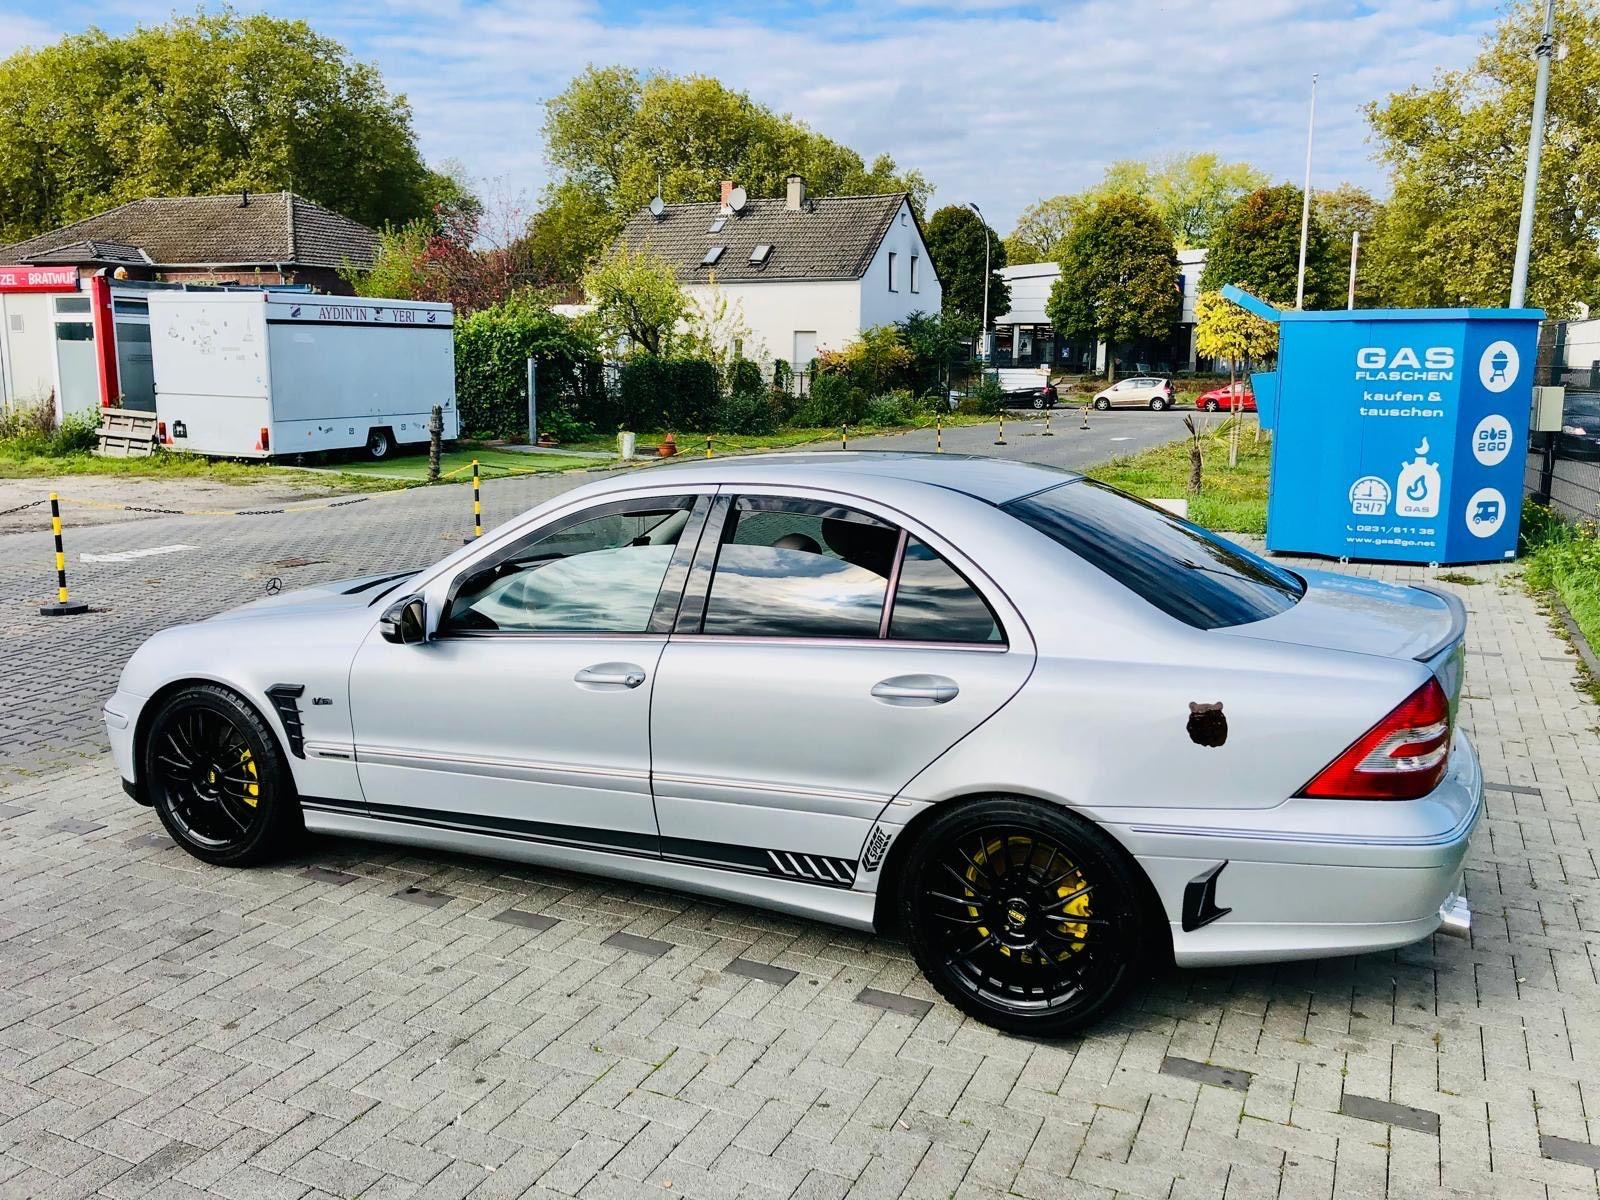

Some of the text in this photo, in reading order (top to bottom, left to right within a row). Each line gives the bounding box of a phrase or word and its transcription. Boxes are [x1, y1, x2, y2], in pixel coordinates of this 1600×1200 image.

[392, 310, 415, 322] YERI
[1356, 347, 1454, 369] GAS
[1355, 371, 1453, 381] FLASCHEN
[1363, 391, 1442, 402] kaufen &
[1360, 406, 1444, 417] tauschen
[1478, 441, 1506, 451] 2GO
[1355, 502, 1382, 513] 24/7
[1346, 537, 1436, 547] www.gas2go.net
[870, 829, 886, 860] SPORT
